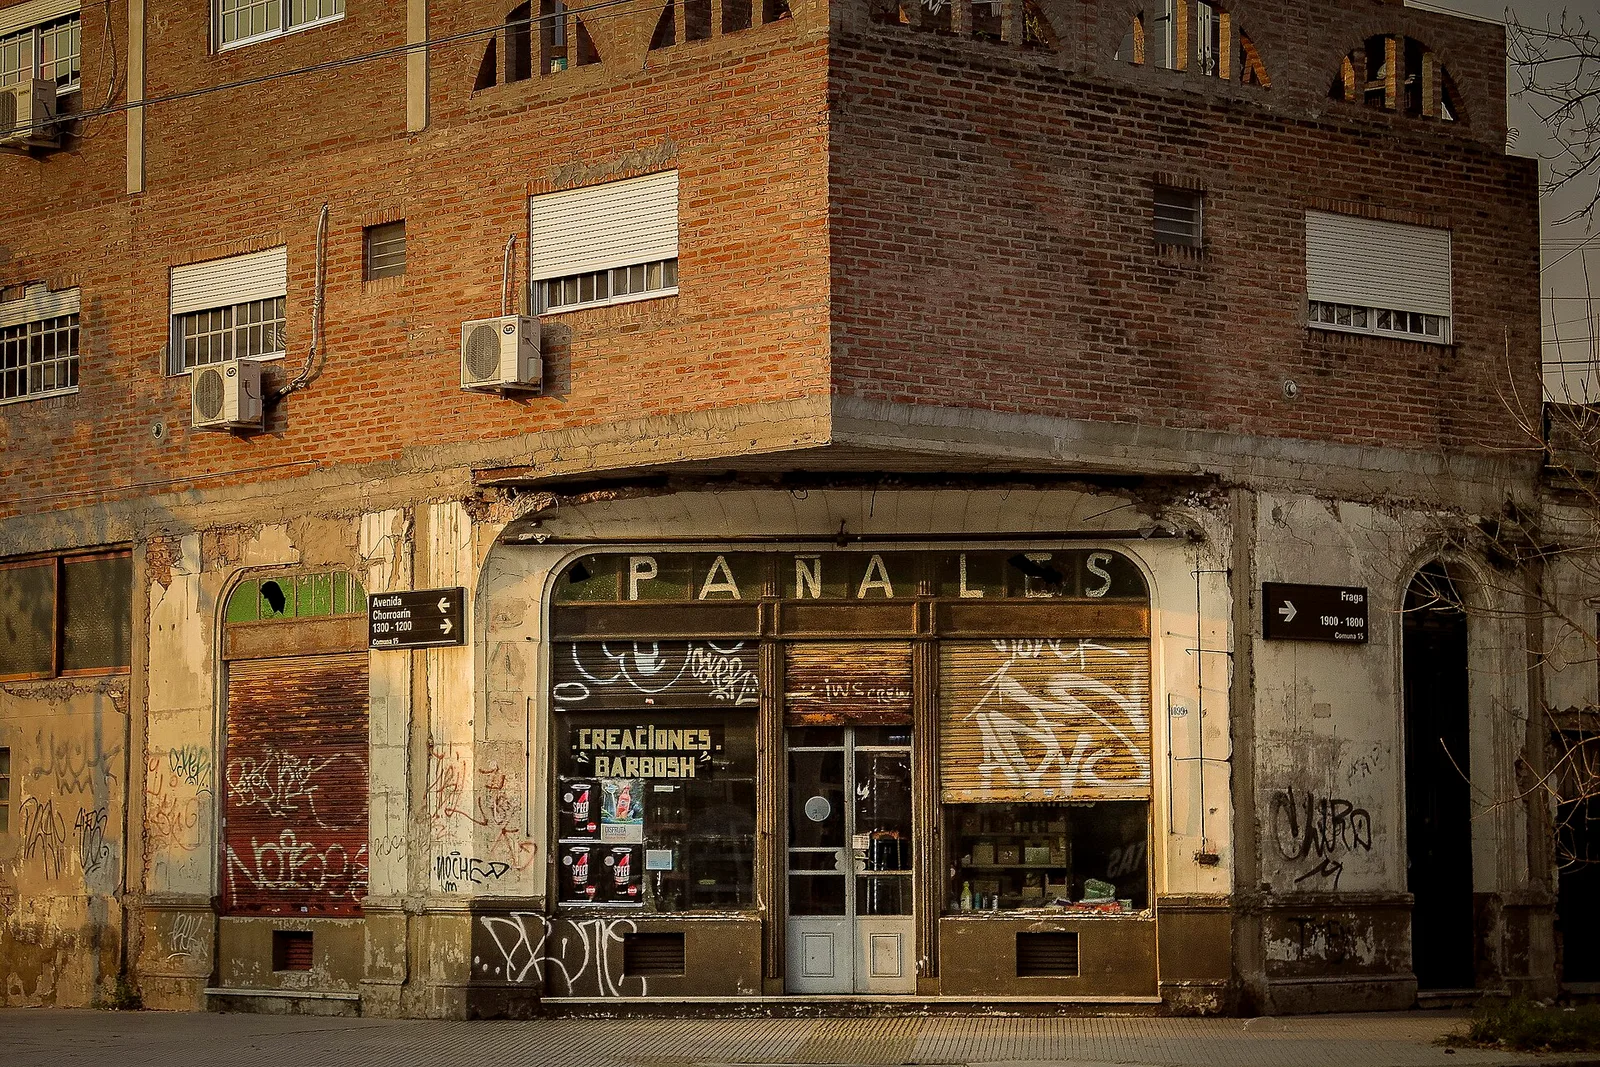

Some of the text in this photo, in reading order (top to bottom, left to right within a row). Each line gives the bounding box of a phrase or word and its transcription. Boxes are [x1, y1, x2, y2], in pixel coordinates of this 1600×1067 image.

[372, 596, 402, 608] Avenida
[1341, 591, 1364, 604] Fraga
[372, 608, 411, 620] Chorroarín
[372, 622, 389, 633] 1300
[395, 621, 412, 632] 1200
[1320, 616, 1339, 626] 1900
[1346, 617, 1364, 628] 1800
[1334, 632, 1357, 640] Comuna
[594, 756, 696, 777] BARBOSH
